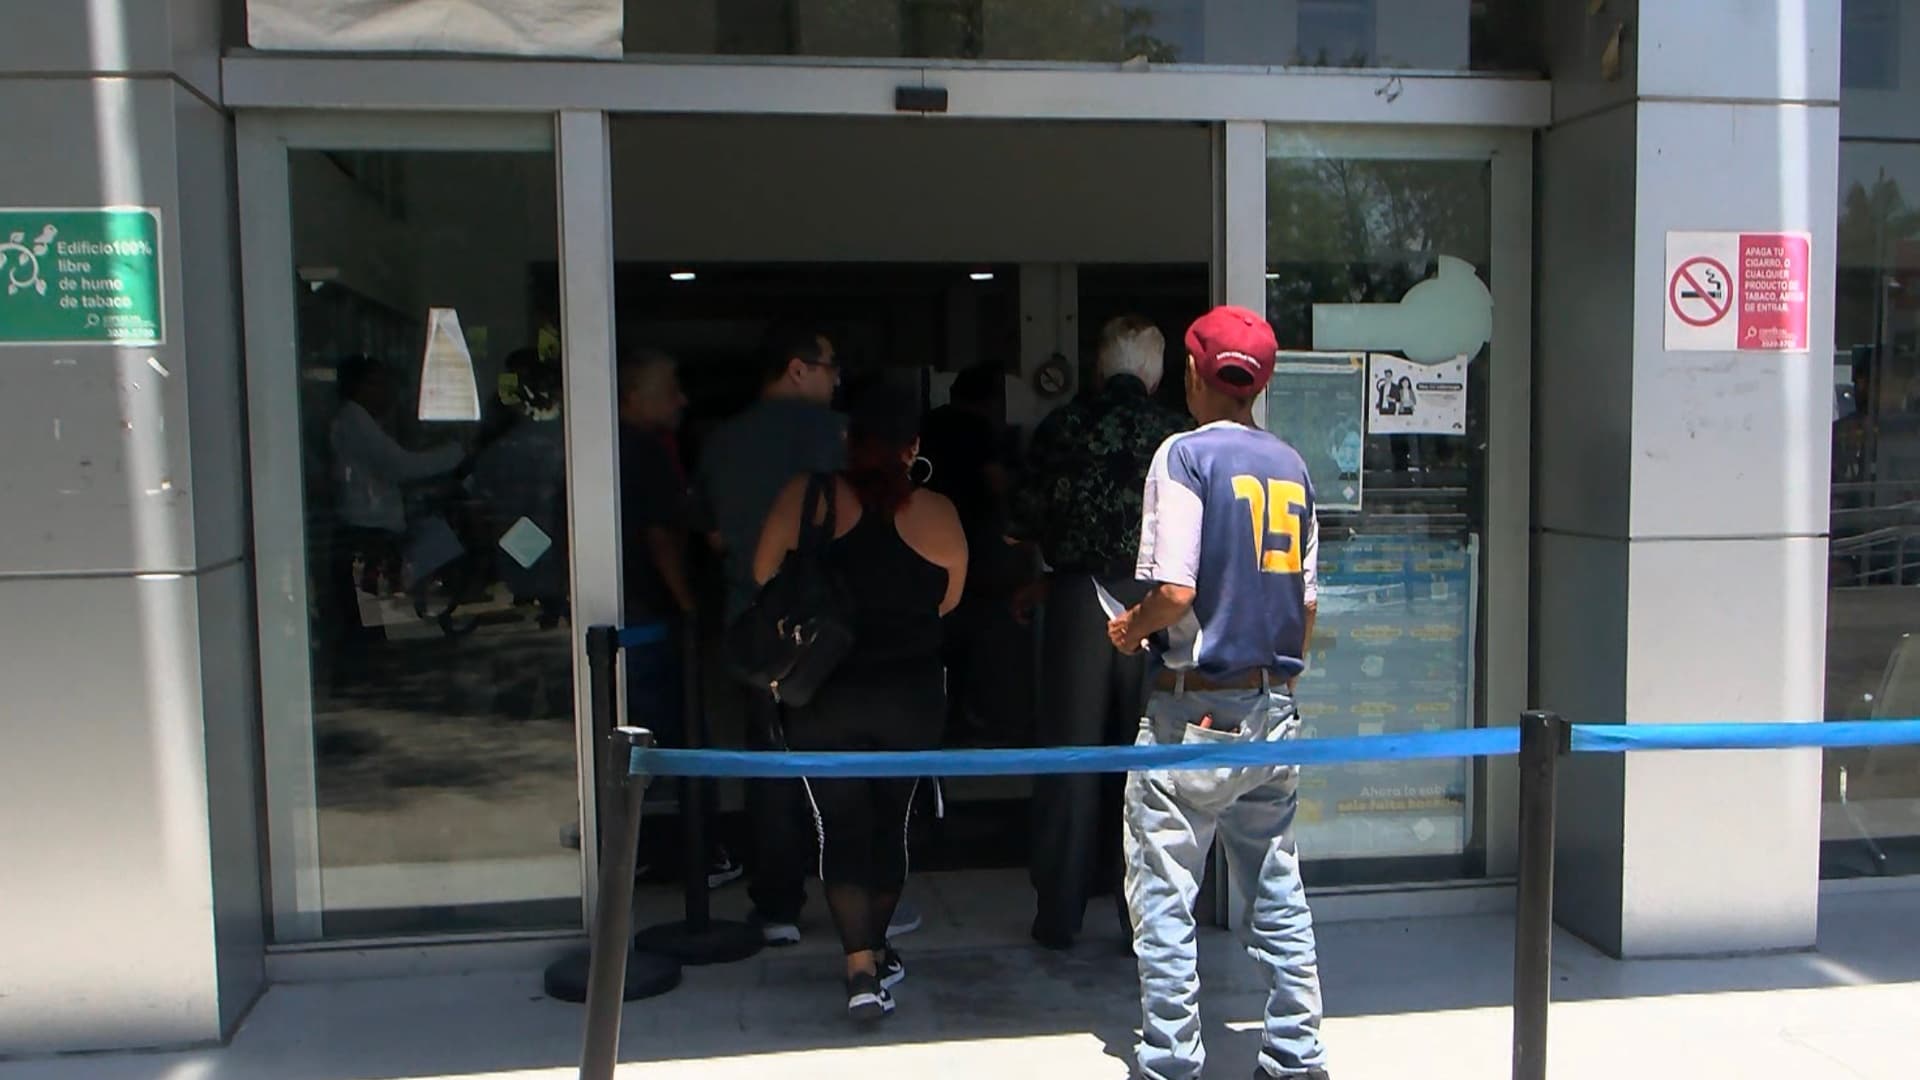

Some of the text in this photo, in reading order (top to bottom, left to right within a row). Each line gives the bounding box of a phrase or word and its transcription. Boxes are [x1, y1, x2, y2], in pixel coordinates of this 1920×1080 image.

[57, 241, 112, 255] Edificio
[1745, 247, 1785, 257] APAGA TU
[58, 260, 91, 273] libre
[1784, 258, 1791, 268] O
[1745, 269, 1790, 279] CUALQUIER
[59, 277, 124, 291] de humo
[1744, 280, 1788, 290] PRODUCTO
[60, 295, 132, 309] de tabaco
[1744, 302, 1755, 312] DE
[1360, 784, 1401, 797] Ahora
[1404, 784, 1417, 797] lo
